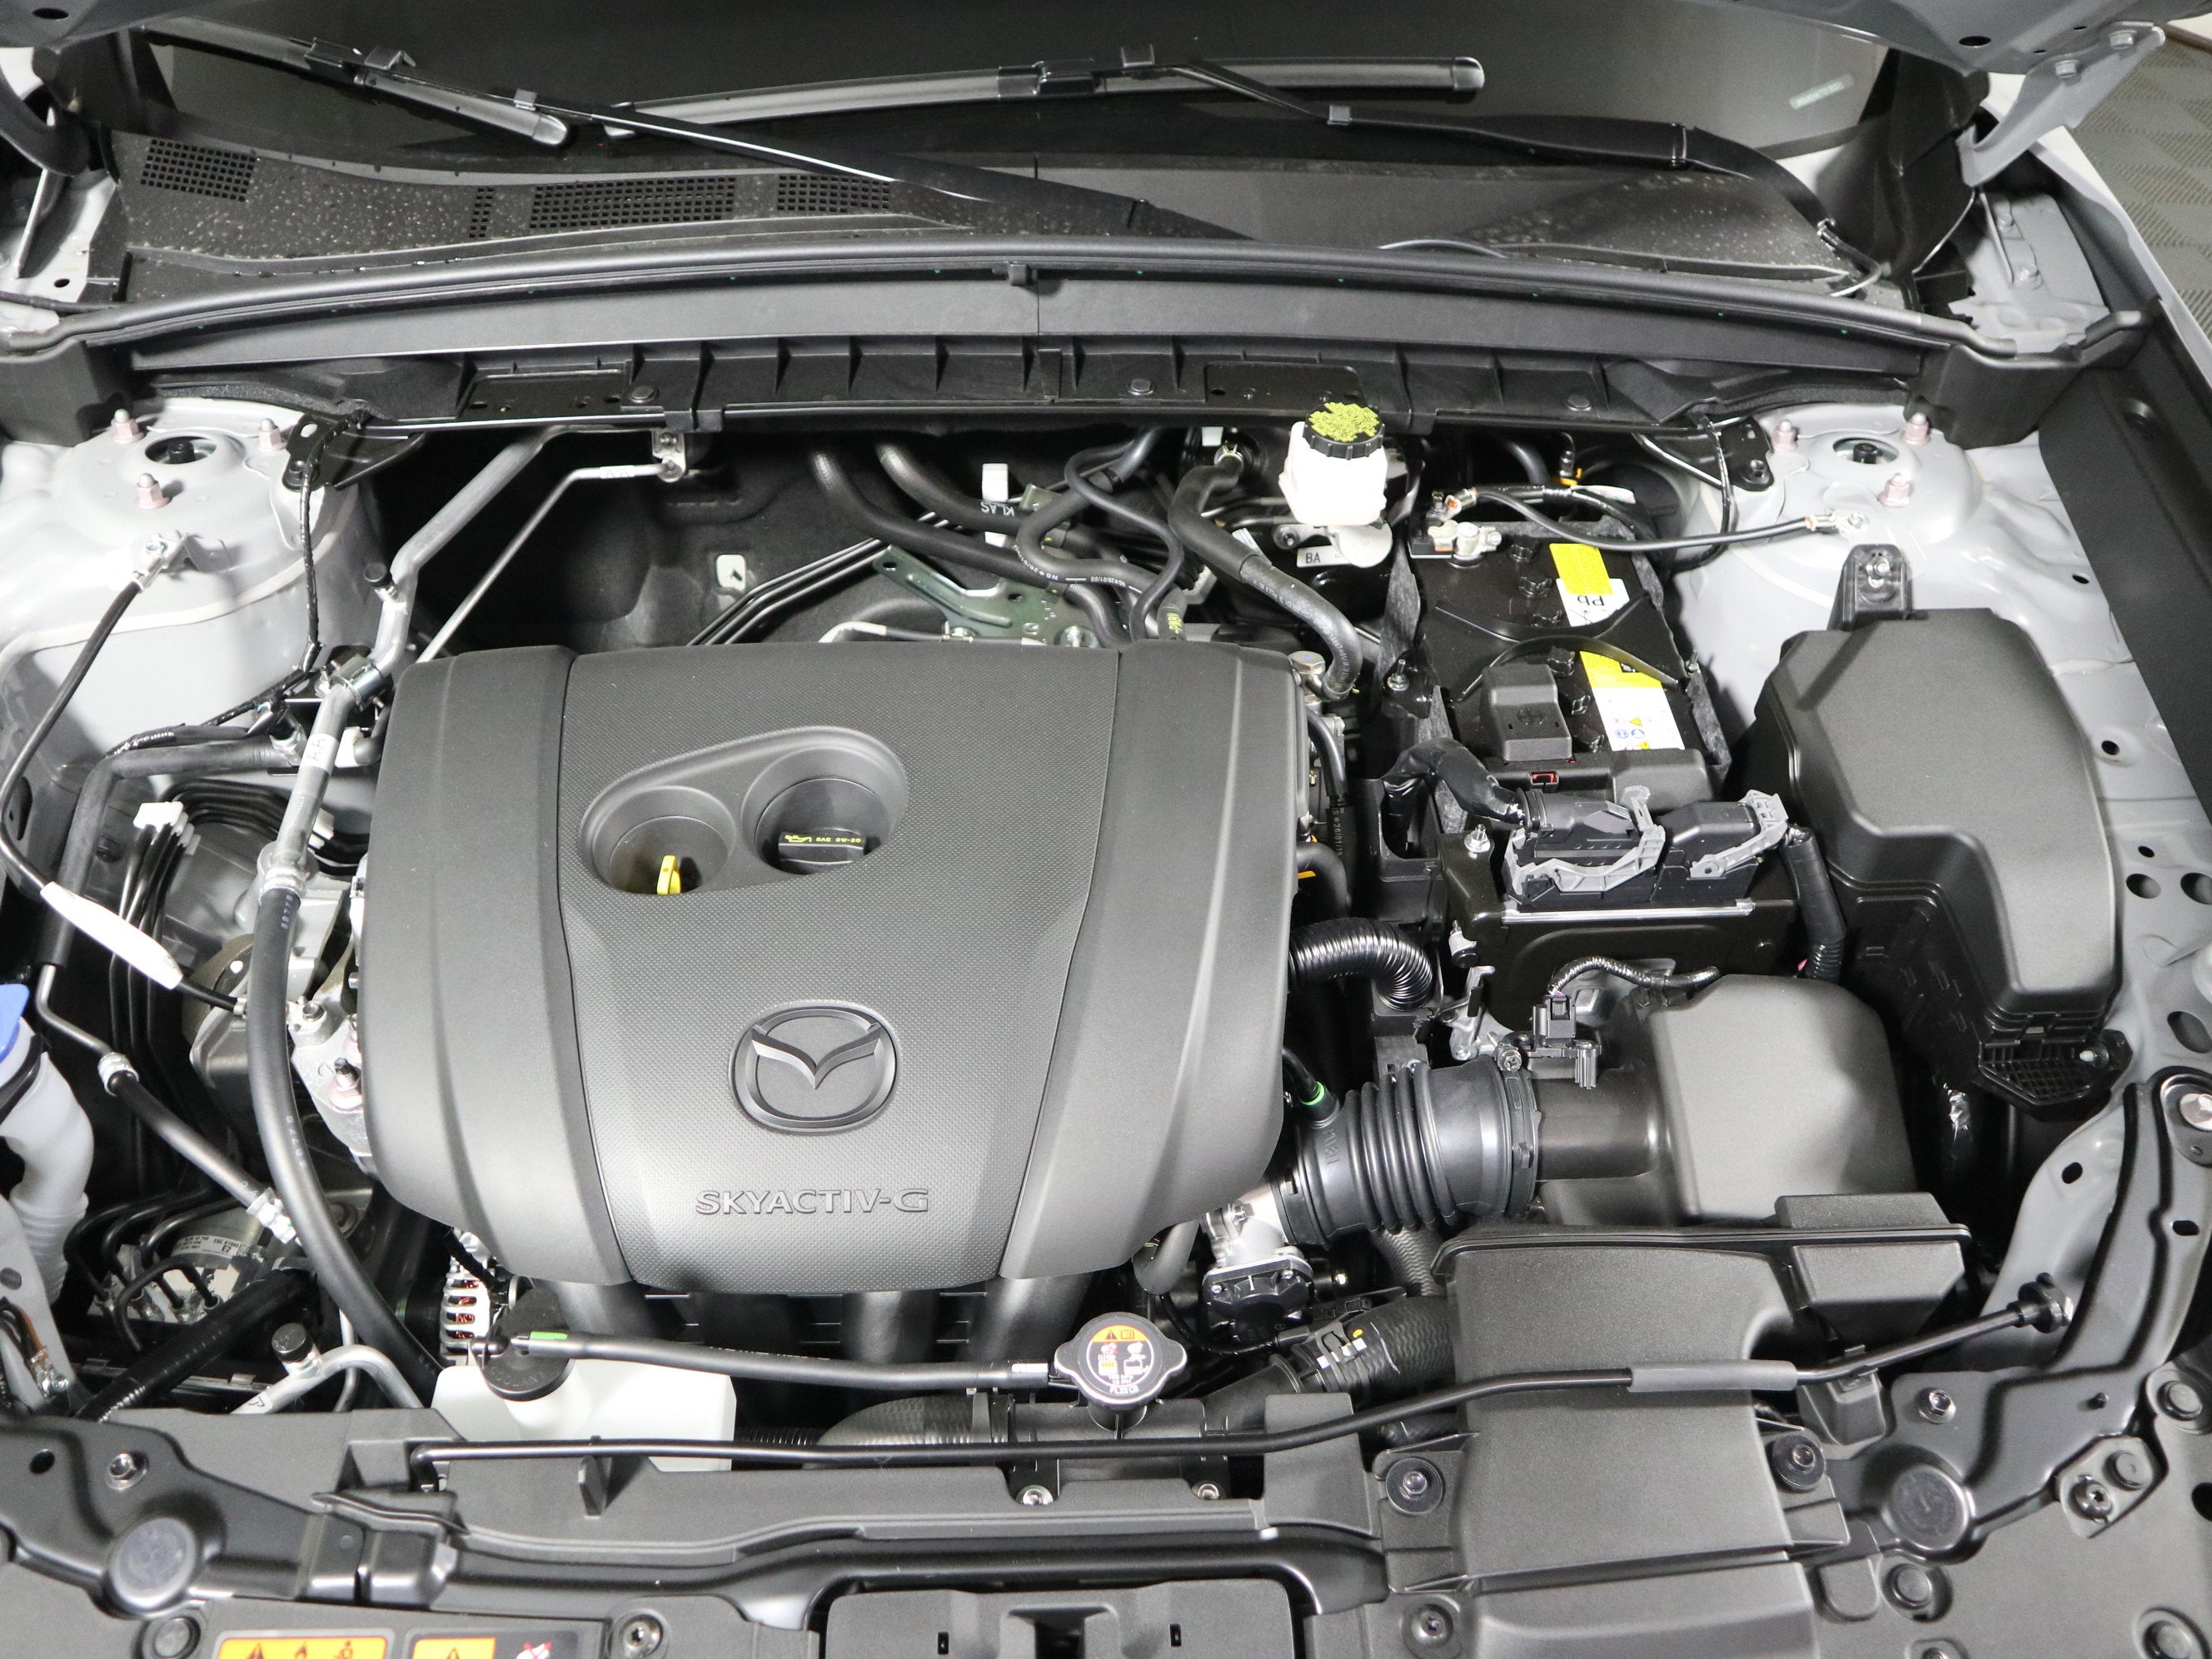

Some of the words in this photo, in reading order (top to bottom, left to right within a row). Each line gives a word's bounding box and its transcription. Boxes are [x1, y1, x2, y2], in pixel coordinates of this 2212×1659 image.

[1305, 552, 1321, 564] BA
[1577, 595, 1605, 606] Pb
[695, 1188, 929, 1215] SKYACTIV-G
